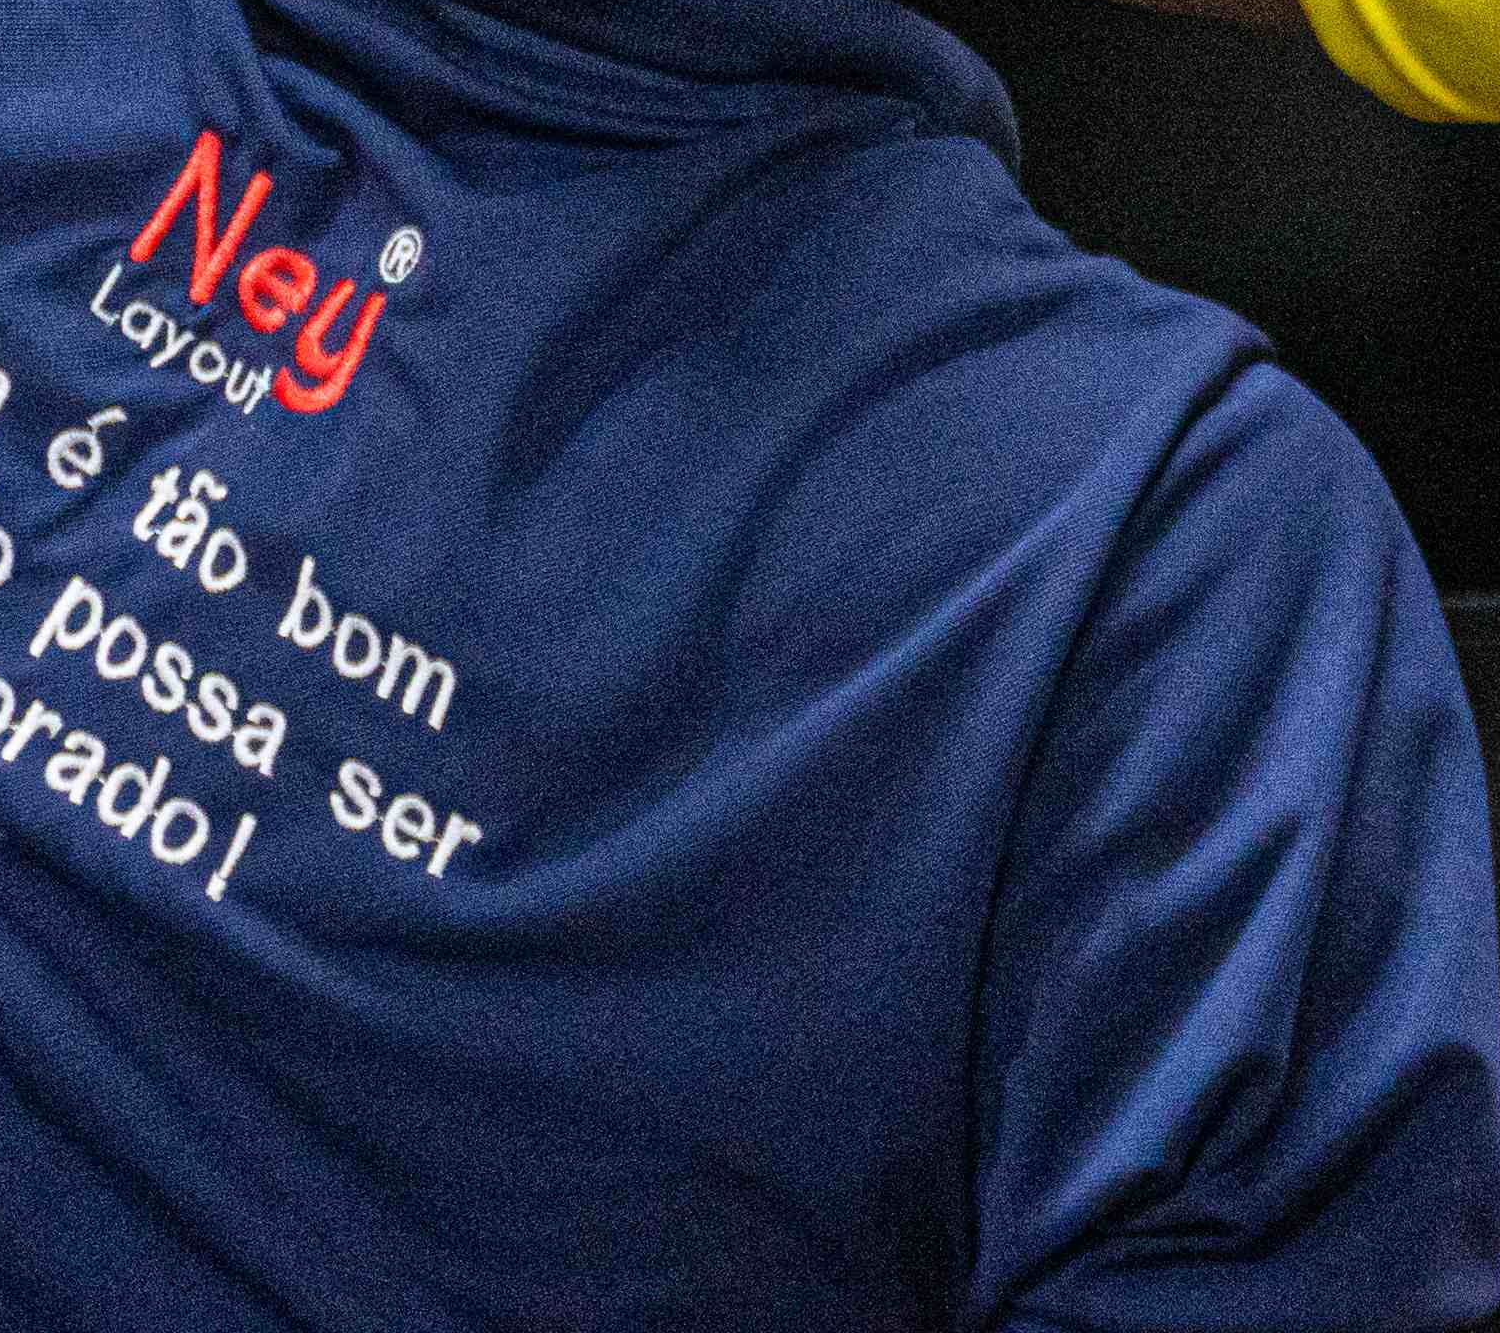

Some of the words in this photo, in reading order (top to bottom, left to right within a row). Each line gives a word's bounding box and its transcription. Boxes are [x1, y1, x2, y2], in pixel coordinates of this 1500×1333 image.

[90, 263, 273, 416] Layout
[129, 128, 388, 414] Ney
[47, 406, 128, 489] é
[132, 464, 250, 593] tão
[277, 556, 458, 731] bom
[29, 576, 287, 777] possa
[329, 759, 483, 879] ser
